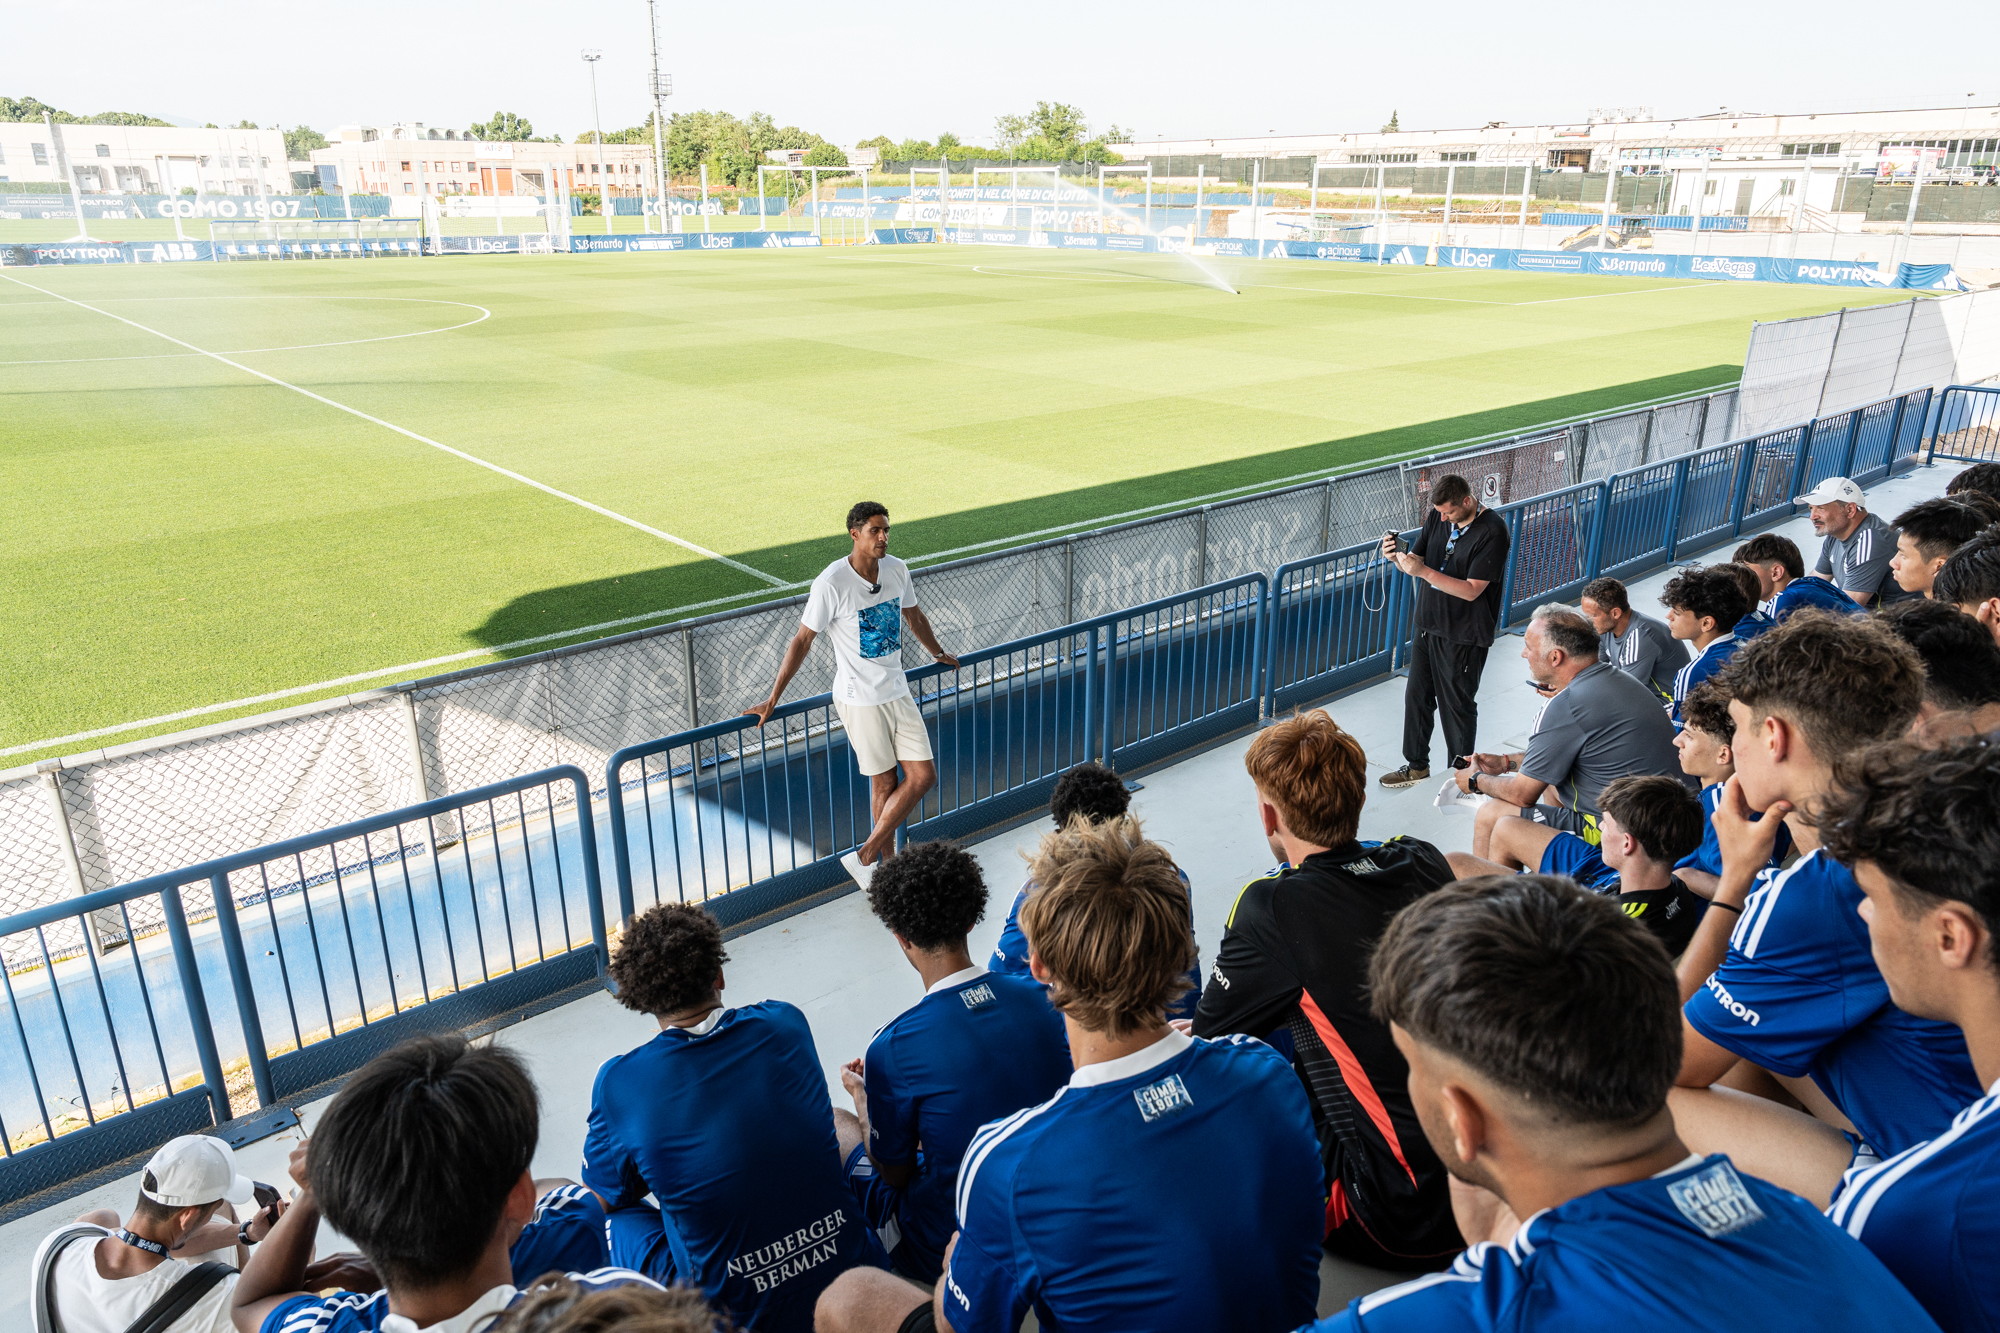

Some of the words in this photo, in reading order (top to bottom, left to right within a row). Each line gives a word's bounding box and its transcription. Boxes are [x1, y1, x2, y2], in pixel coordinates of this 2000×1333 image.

[158, 200, 238, 218] COMO
[243, 200, 300, 218] 1907
[468, 237, 509, 250] Uber
[574, 238, 623, 250] S.Bernardo
[700, 234, 734, 249] Uber
[152, 243, 198, 261] ABB
[1452, 248, 1496, 268] Uber
[1599, 257, 1666, 273] S.Bernardo
[965, 986, 986, 998] COMO
[968, 992, 988, 1005] 1907
[1142, 1081, 1177, 1103] COMO
[1148, 1091, 1180, 1115] 1907
[1683, 1172, 1733, 1209] COMO
[1698, 1196, 1746, 1229] 1907
[727, 1208, 847, 1278] NEUBERGER
[752, 1238, 838, 1294] BERMAN
